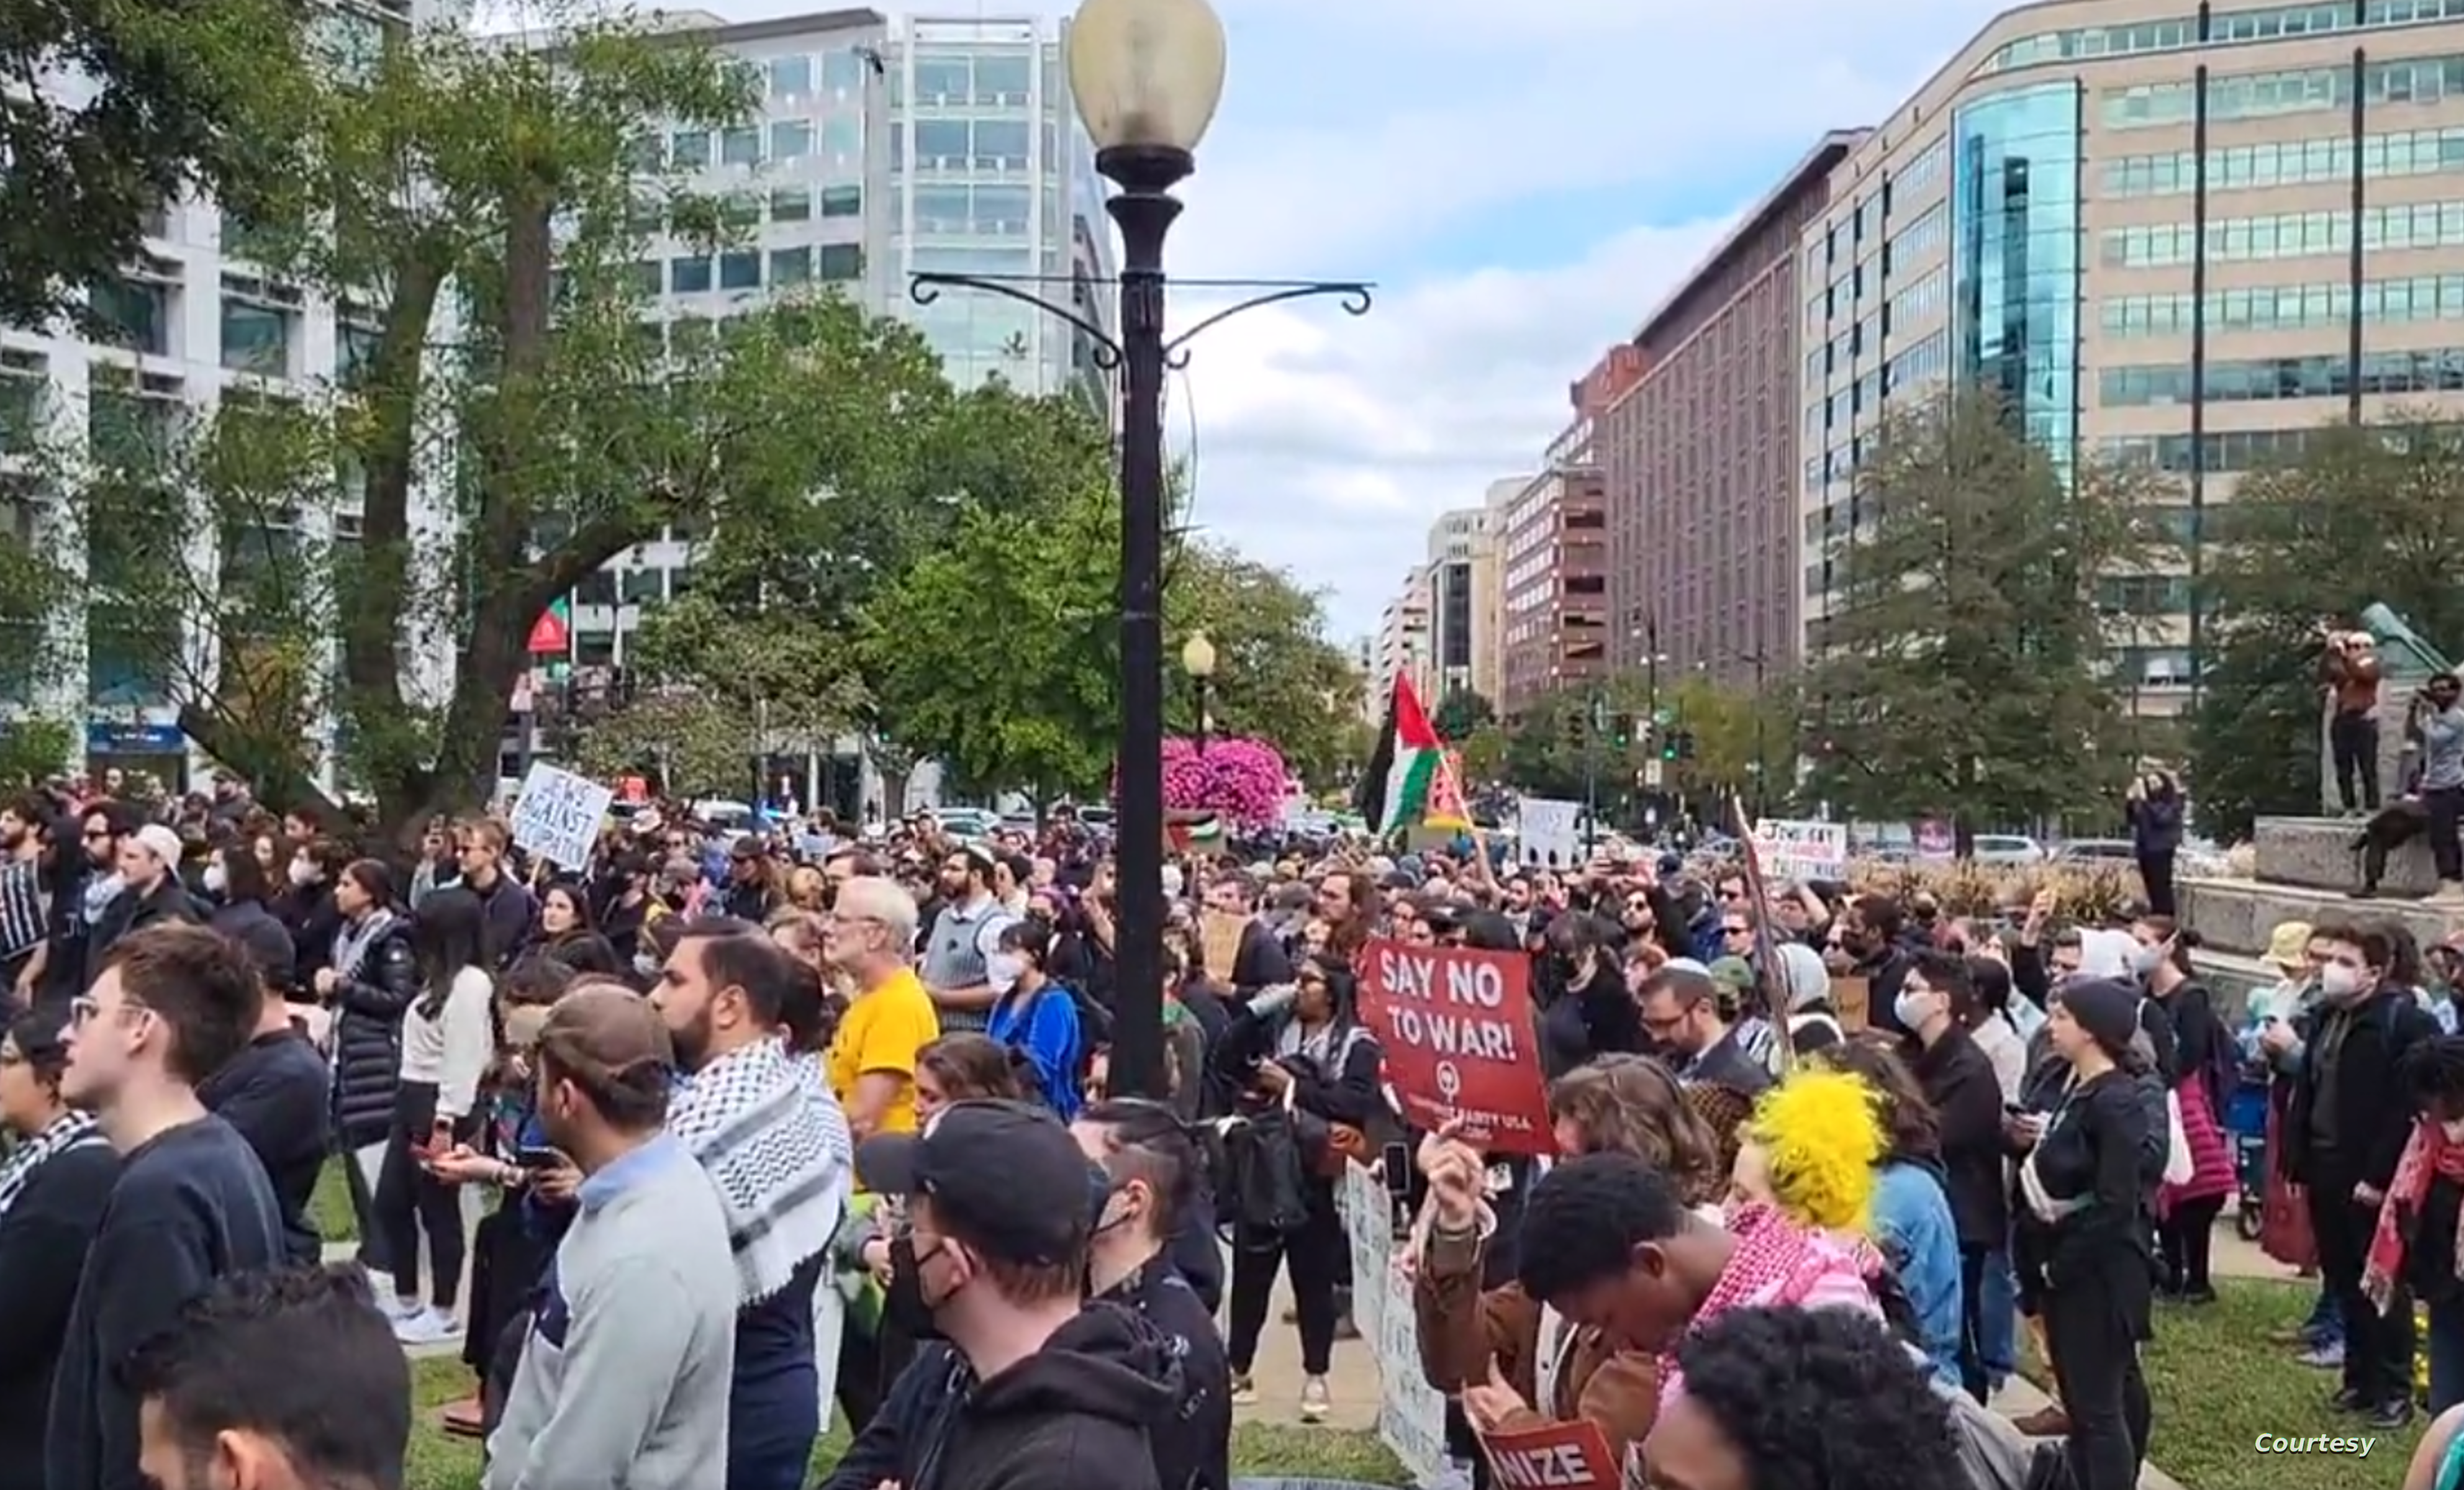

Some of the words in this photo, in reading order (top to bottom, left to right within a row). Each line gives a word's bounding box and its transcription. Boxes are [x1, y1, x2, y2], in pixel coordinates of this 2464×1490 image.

[1380, 948, 1436, 999] SAY
[1447, 959, 1503, 1008] NO
[1387, 1005, 1423, 1045] TO
[1426, 1012, 1517, 1061] WAR!
